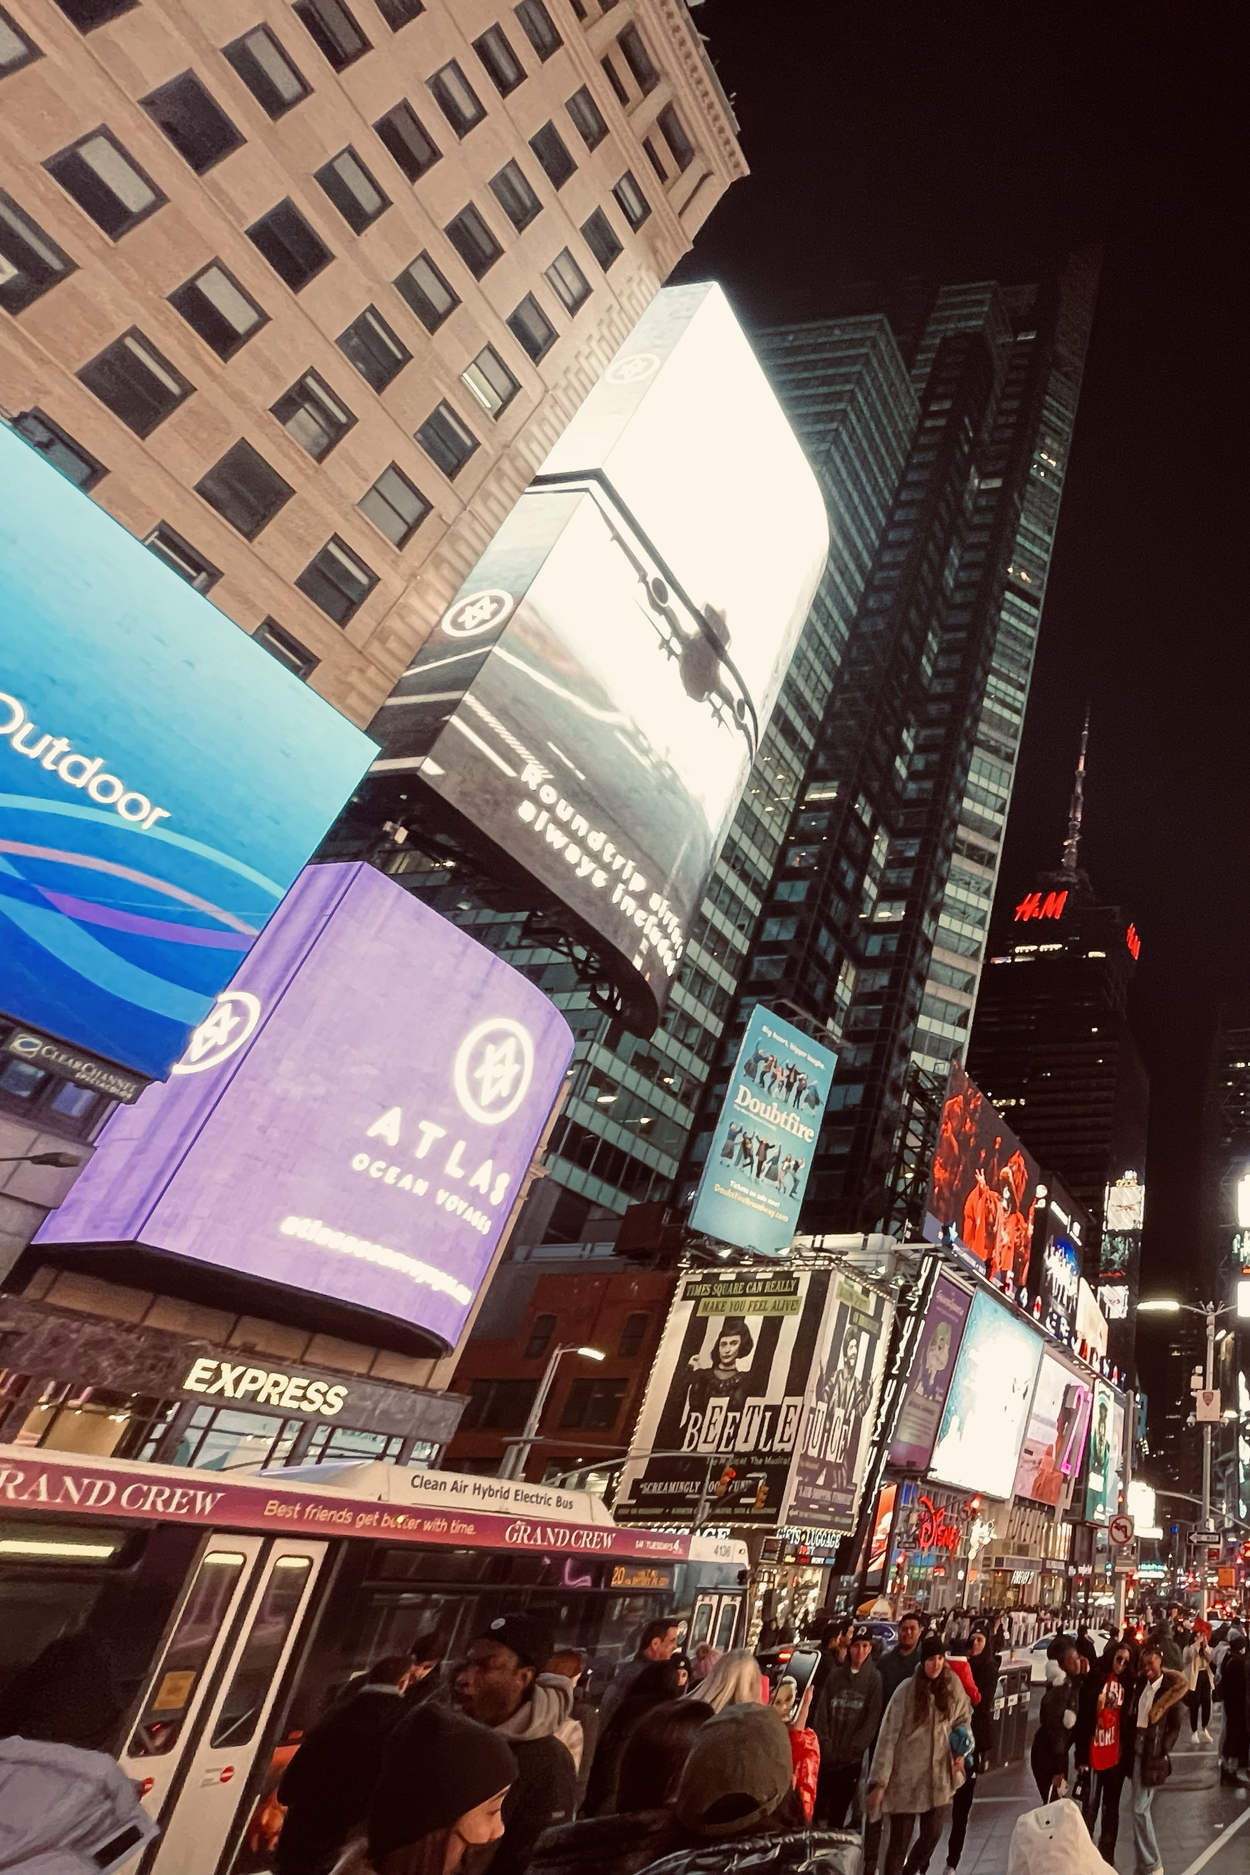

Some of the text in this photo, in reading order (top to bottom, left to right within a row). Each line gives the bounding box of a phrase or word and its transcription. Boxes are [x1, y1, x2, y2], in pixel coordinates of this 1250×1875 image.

[517, 799, 609, 888] always
[521, 763, 647, 892] Roundtrip
[1014, 890, 1069, 922] H&M
[735, 1084, 815, 1142] Doubtfire
[366, 1106, 511, 1206] ATLAS
[352, 1153, 492, 1235] OCEAN VOYAGES
[686, 1279, 797, 1297] TIMES SQUARE CAN REALLY
[701, 1301, 728, 1313] MAKE
[729, 1300, 746, 1313] YOU
[748, 1300, 768, 1312] FEEL
[183, 1357, 349, 1416] EXPRESS
[120, 1482, 226, 1517] CREW
[410, 1474, 575, 1511] Clean Air Hybrid Electric Bus
[264, 1500, 300, 1520] Best
[303, 1501, 353, 1525] friends
[355, 1510, 380, 1530] get
[423, 1516, 449, 1533] with
[450, 1518, 478, 1537] time.
[505, 1523, 616, 1550] GRAND CREW
[804, 1529, 842, 1549] LUGGAGE
